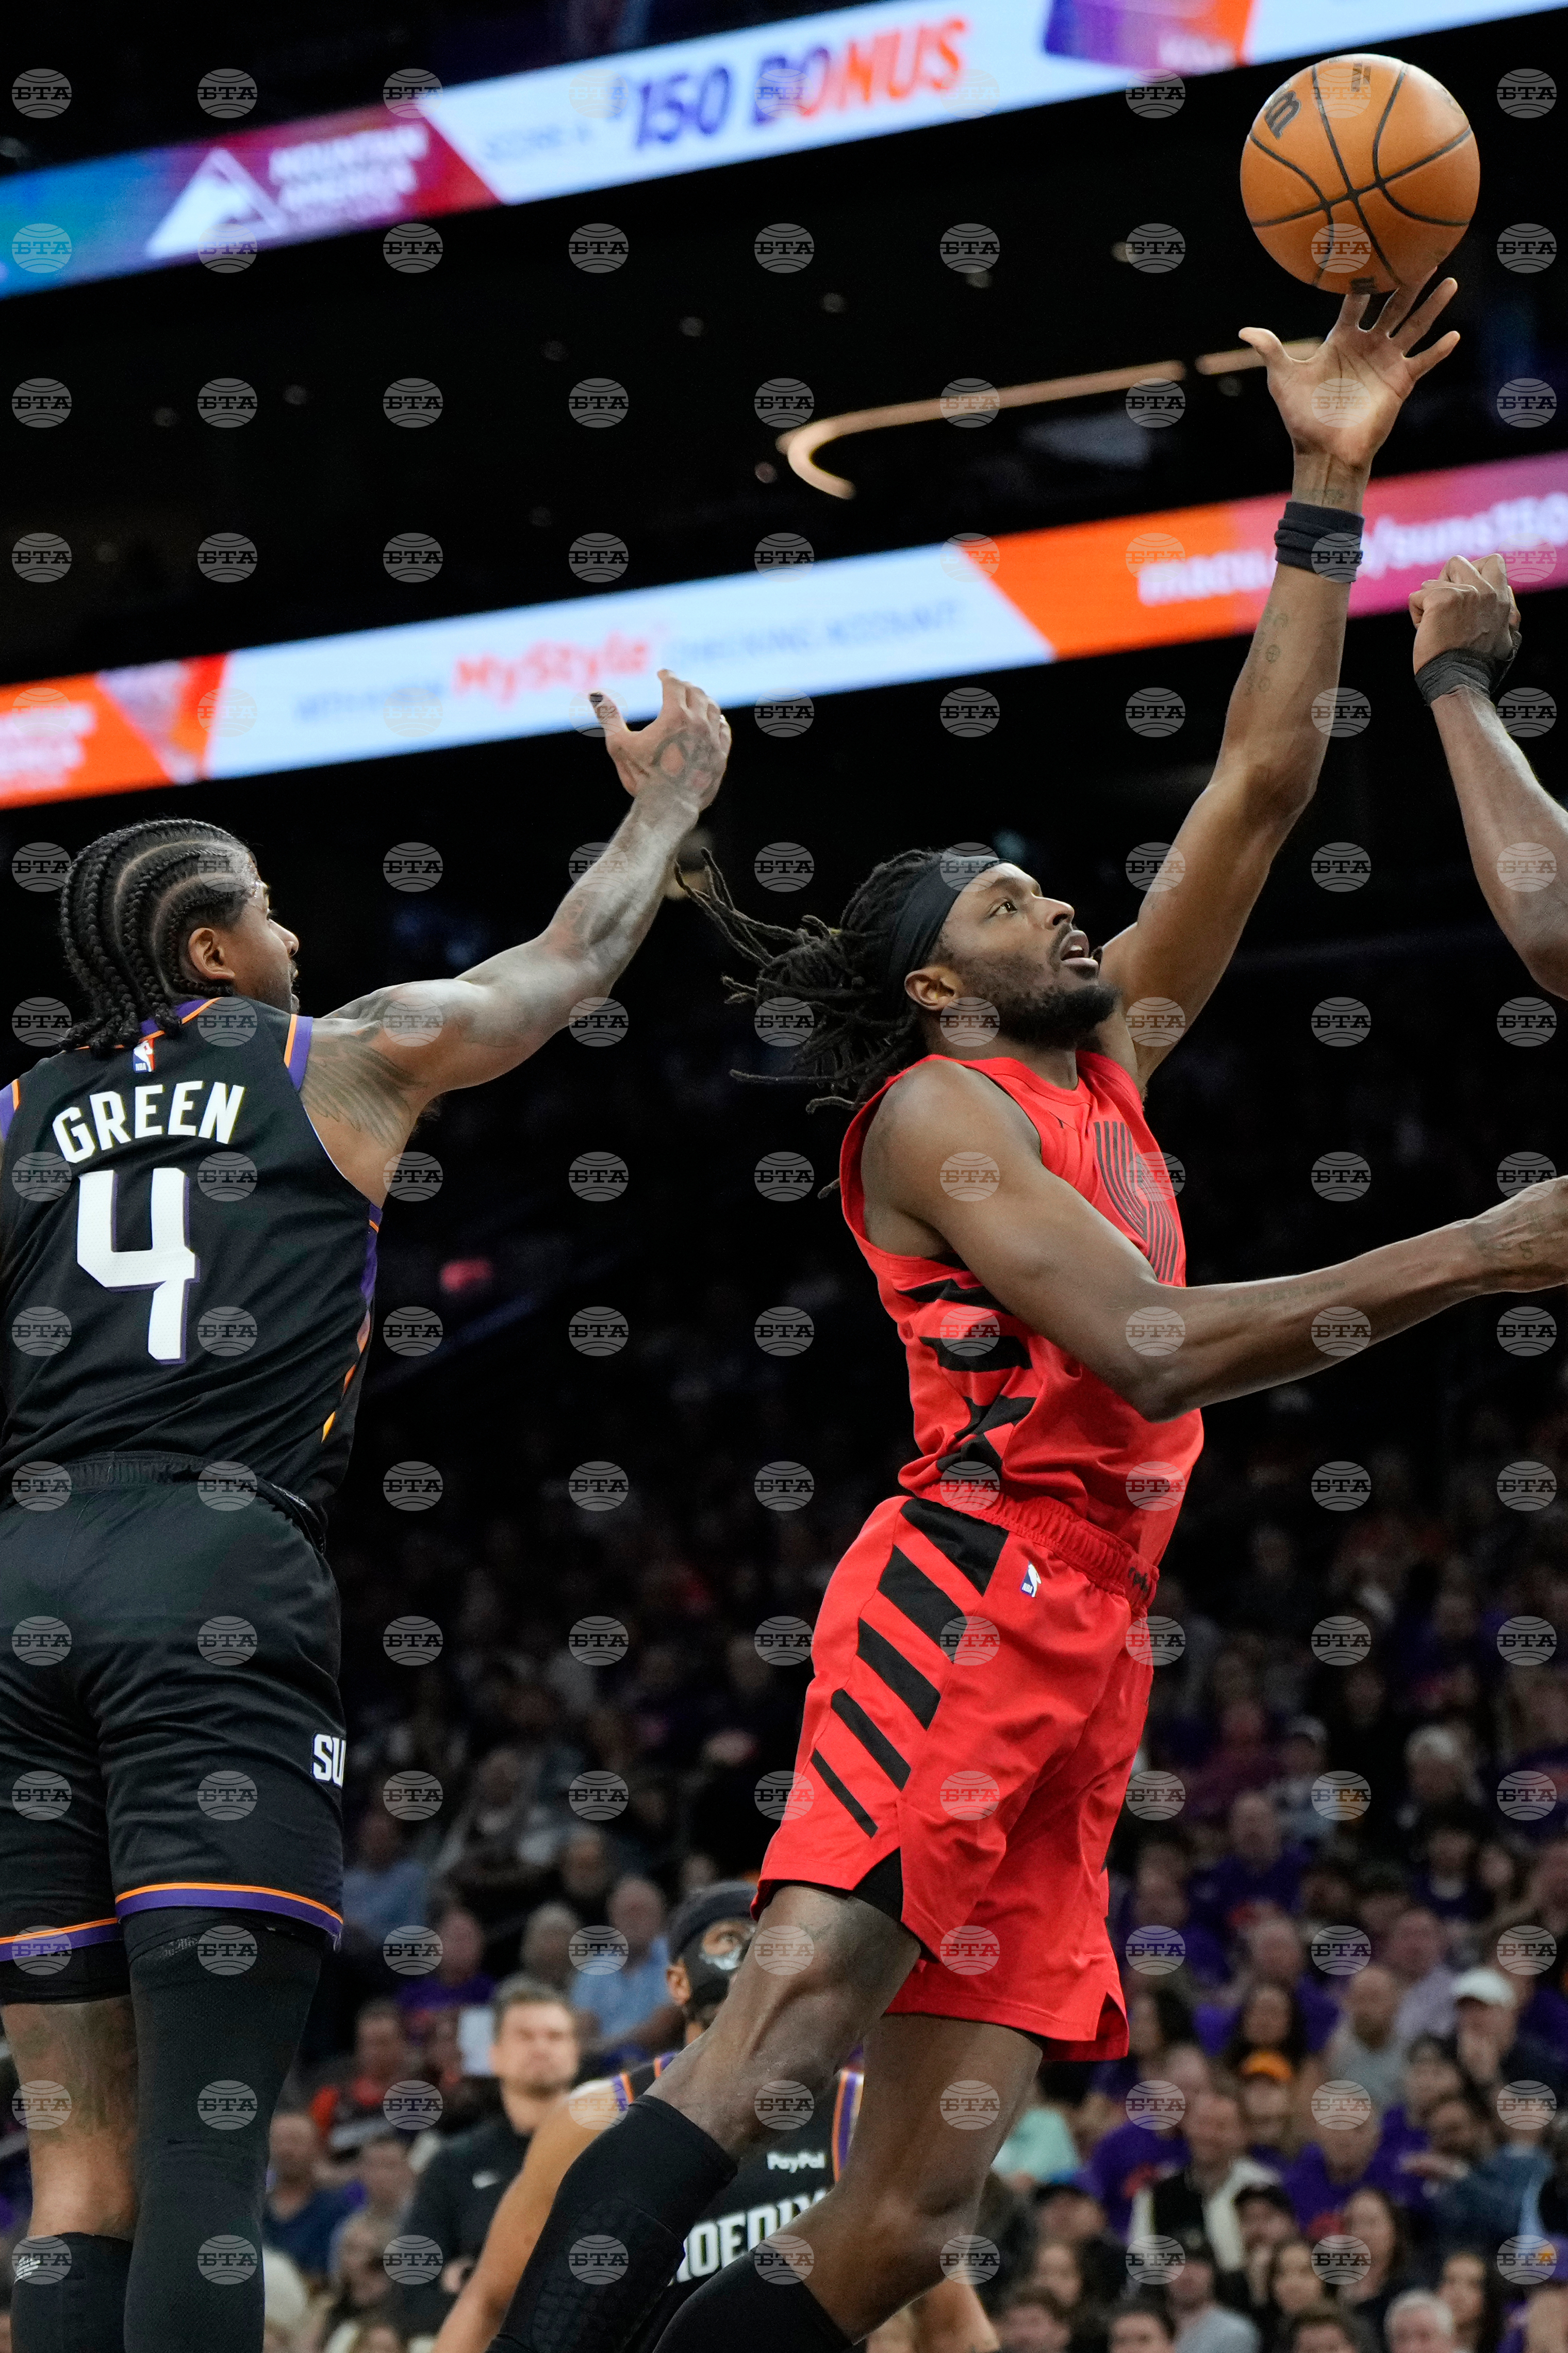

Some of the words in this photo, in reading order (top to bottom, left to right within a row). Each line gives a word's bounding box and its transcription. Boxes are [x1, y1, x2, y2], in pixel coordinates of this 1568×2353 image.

[753, 14, 967, 126] BONUS
[135, 1063, 147, 1071] NBA
[53, 1080, 245, 1164] GREEN
[77, 1167, 198, 1362] 4
[1021, 1582, 1033, 1594] NBA
